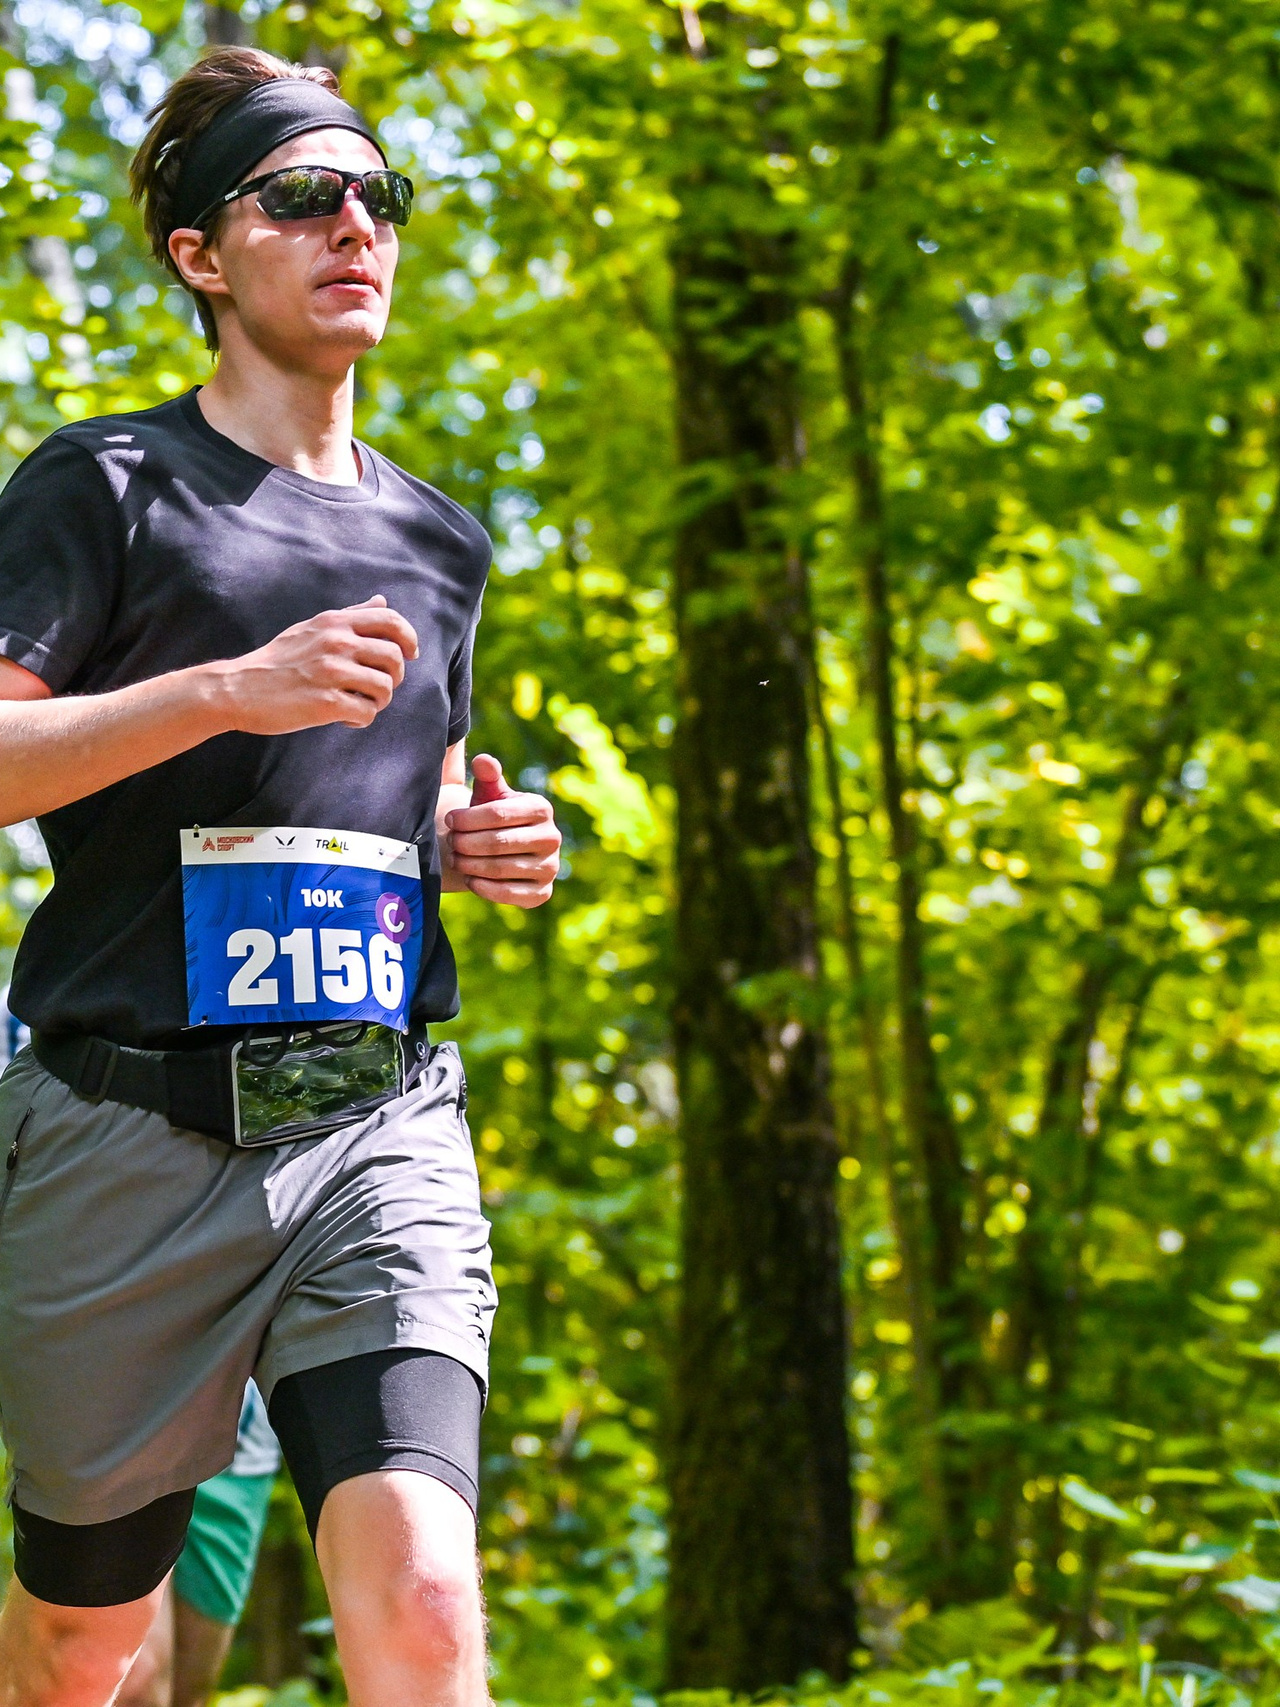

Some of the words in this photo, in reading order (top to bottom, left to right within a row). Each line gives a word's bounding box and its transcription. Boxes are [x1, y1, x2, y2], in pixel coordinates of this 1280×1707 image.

[217, 834, 255, 844] МОСКОВСКИЙ
[217, 843, 235, 851] СПОРТ
[300, 888, 344, 908] 10K
[227, 927, 404, 1010] 2156
